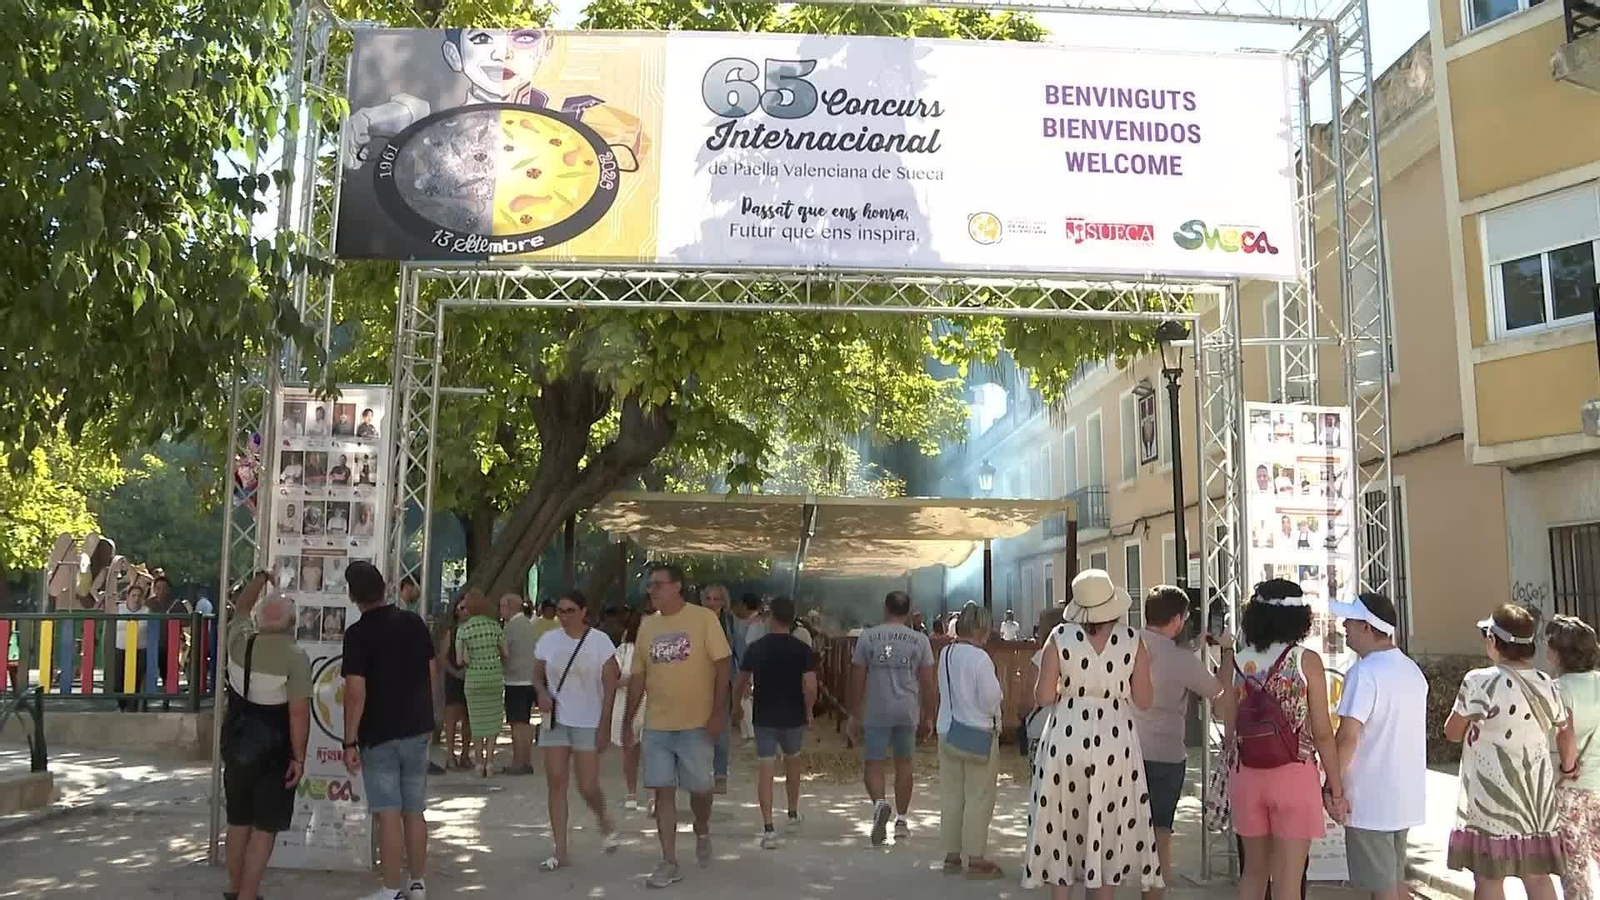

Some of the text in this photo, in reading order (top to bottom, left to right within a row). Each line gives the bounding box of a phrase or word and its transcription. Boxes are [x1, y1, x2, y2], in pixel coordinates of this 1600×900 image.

[702, 57, 945, 120] 65 Concurs
[1045, 84, 1197, 111] BENVINGUTS
[706, 120, 942, 153] Internacional
[1043, 117, 1201, 144] BIENVENIDOS
[379, 143, 400, 179] 1961
[708, 162, 945, 181] de Paella Valenciana de Sueca
[1065, 151, 1183, 176] WELCOME
[741, 196, 793, 220] Passat
[798, 204, 827, 223] que
[832, 206, 857, 221] ens
[431, 229, 454, 247] 13
[729, 223, 776, 239] Futur
[782, 226, 814, 243] que
[821, 226, 851, 241] ens
[1086, 223, 1154, 241] SUECA
